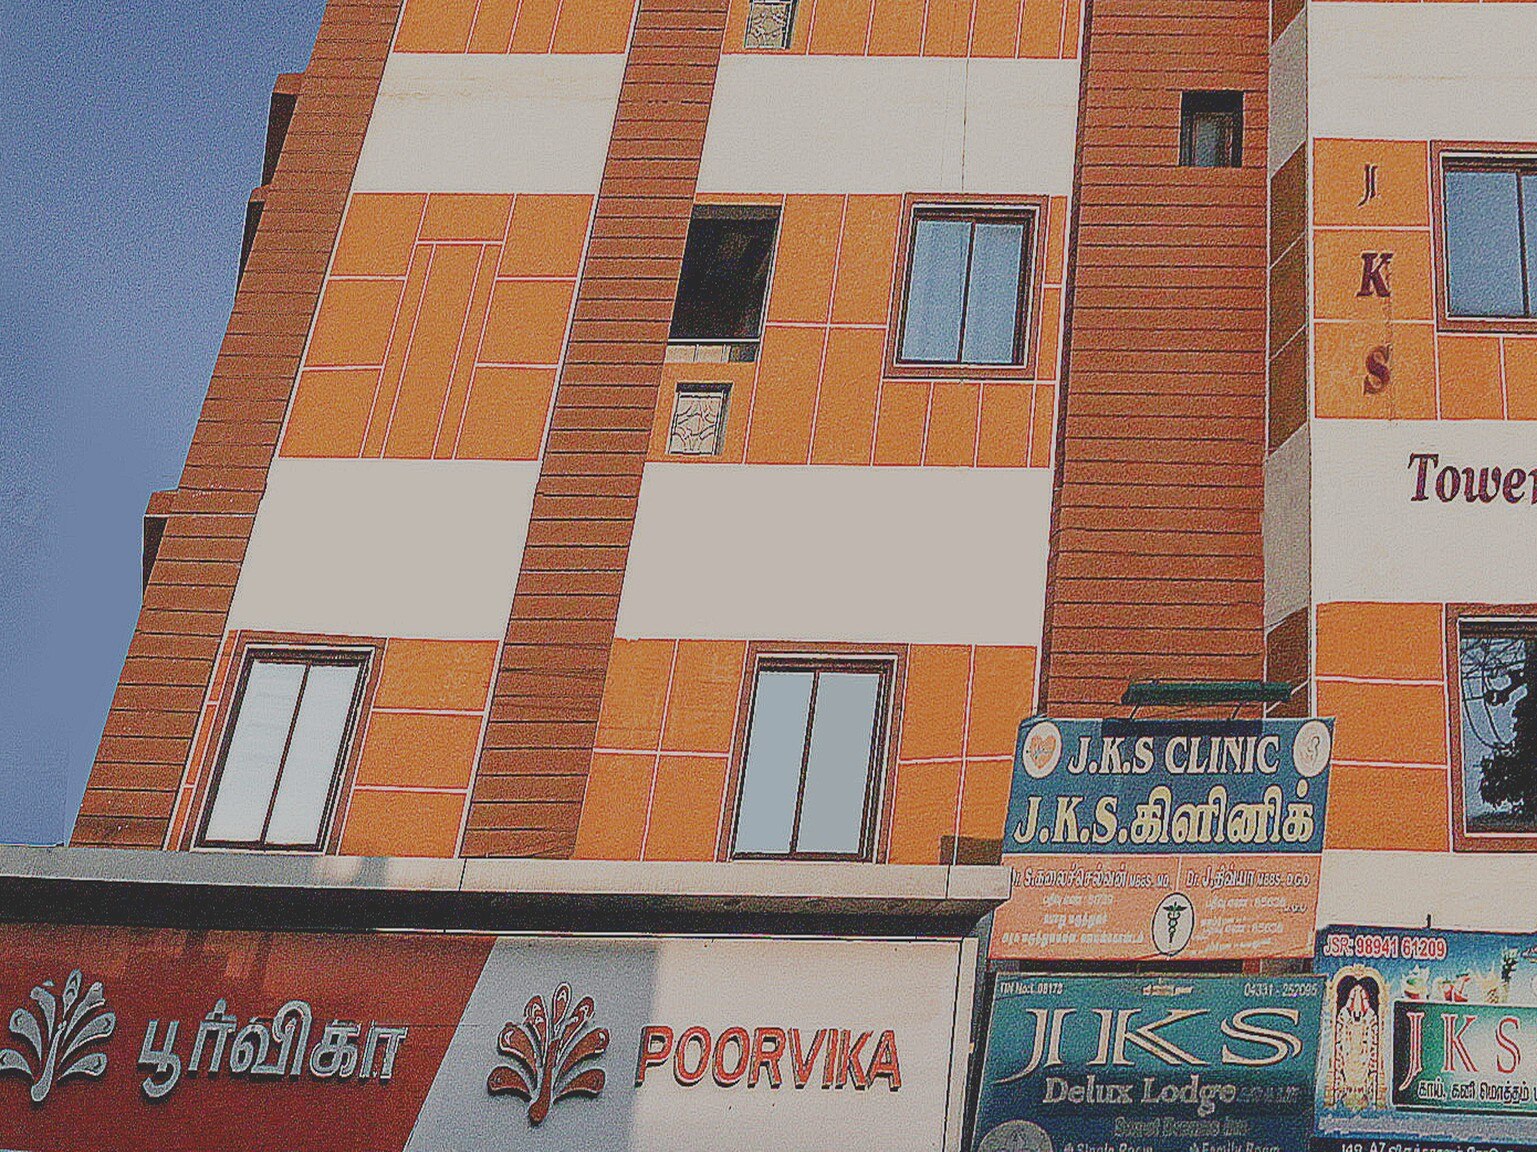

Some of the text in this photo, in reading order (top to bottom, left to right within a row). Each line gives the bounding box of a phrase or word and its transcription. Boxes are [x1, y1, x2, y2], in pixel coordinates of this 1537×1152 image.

[1067, 734, 1280, 775] J.K.S CLINIC
[1355, 935, 1399, 959] 98941
[1402, 936, 1447, 960] 61209
[137, 998, 410, 1098] பூர்விகா
[634, 1025, 902, 1092] POORVIKA
[1043, 1074, 1133, 1104] Delux
[1140, 1074, 1237, 1117] Lodge
